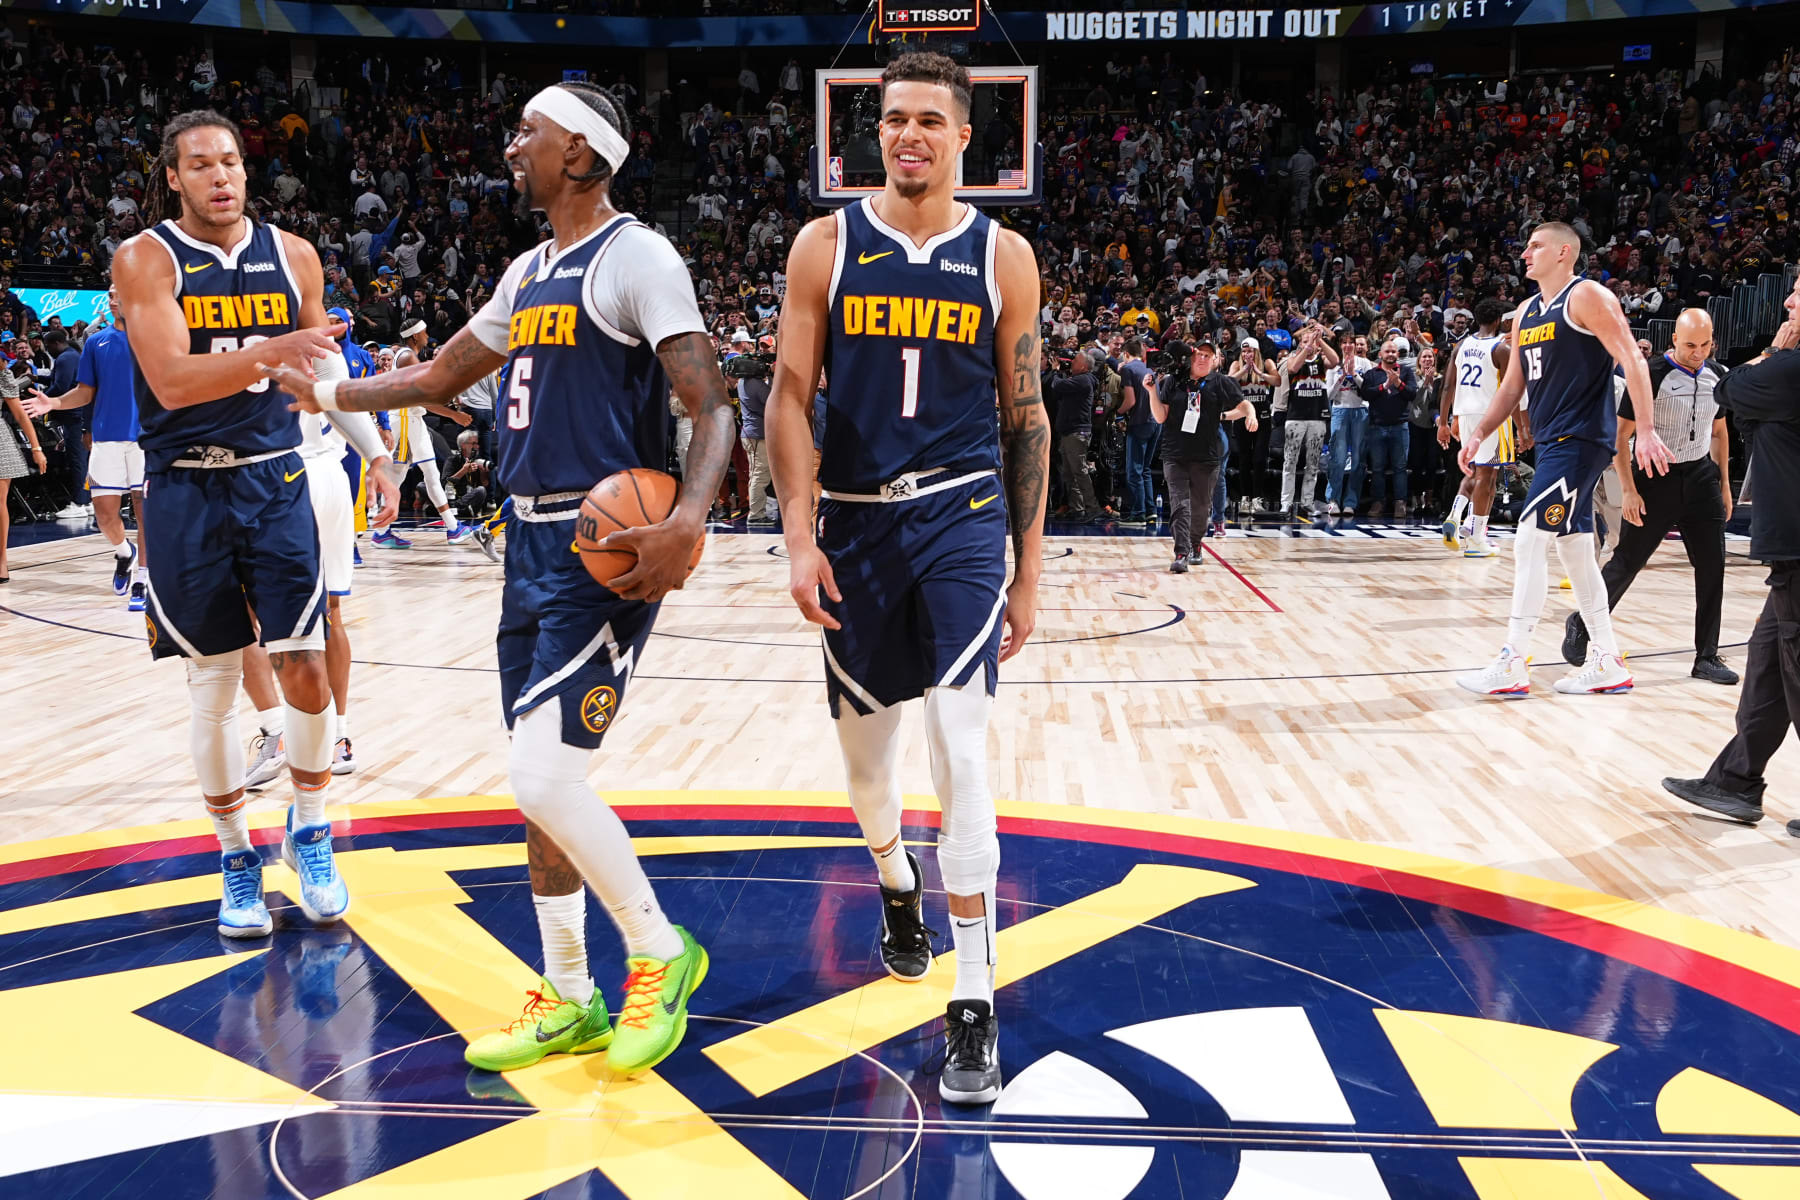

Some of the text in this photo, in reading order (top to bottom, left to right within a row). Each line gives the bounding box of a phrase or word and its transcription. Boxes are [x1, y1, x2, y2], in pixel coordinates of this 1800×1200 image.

[909, 9, 972, 22] TISSOT
[1046, 8, 1341, 40] NUGGETS NIGHT OUT
[1382, 7, 1390, 27] 1
[1404, 0, 1488, 22] TICKET
[243, 262, 276, 273] ibotta
[554, 266, 584, 279] ibotta
[940, 259, 978, 276] ibotta
[40, 290, 78, 315] Ball
[182, 293, 289, 329] DENVER
[842, 295, 982, 344] DENVER
[1464, 348, 1485, 360] WIGGINS
[1524, 346, 1543, 381] 15
[901, 346, 922, 418] 1
[1460, 363, 1483, 388] 22
[507, 356, 534, 430] 5
[1298, 389, 1322, 398] NUGGETS
